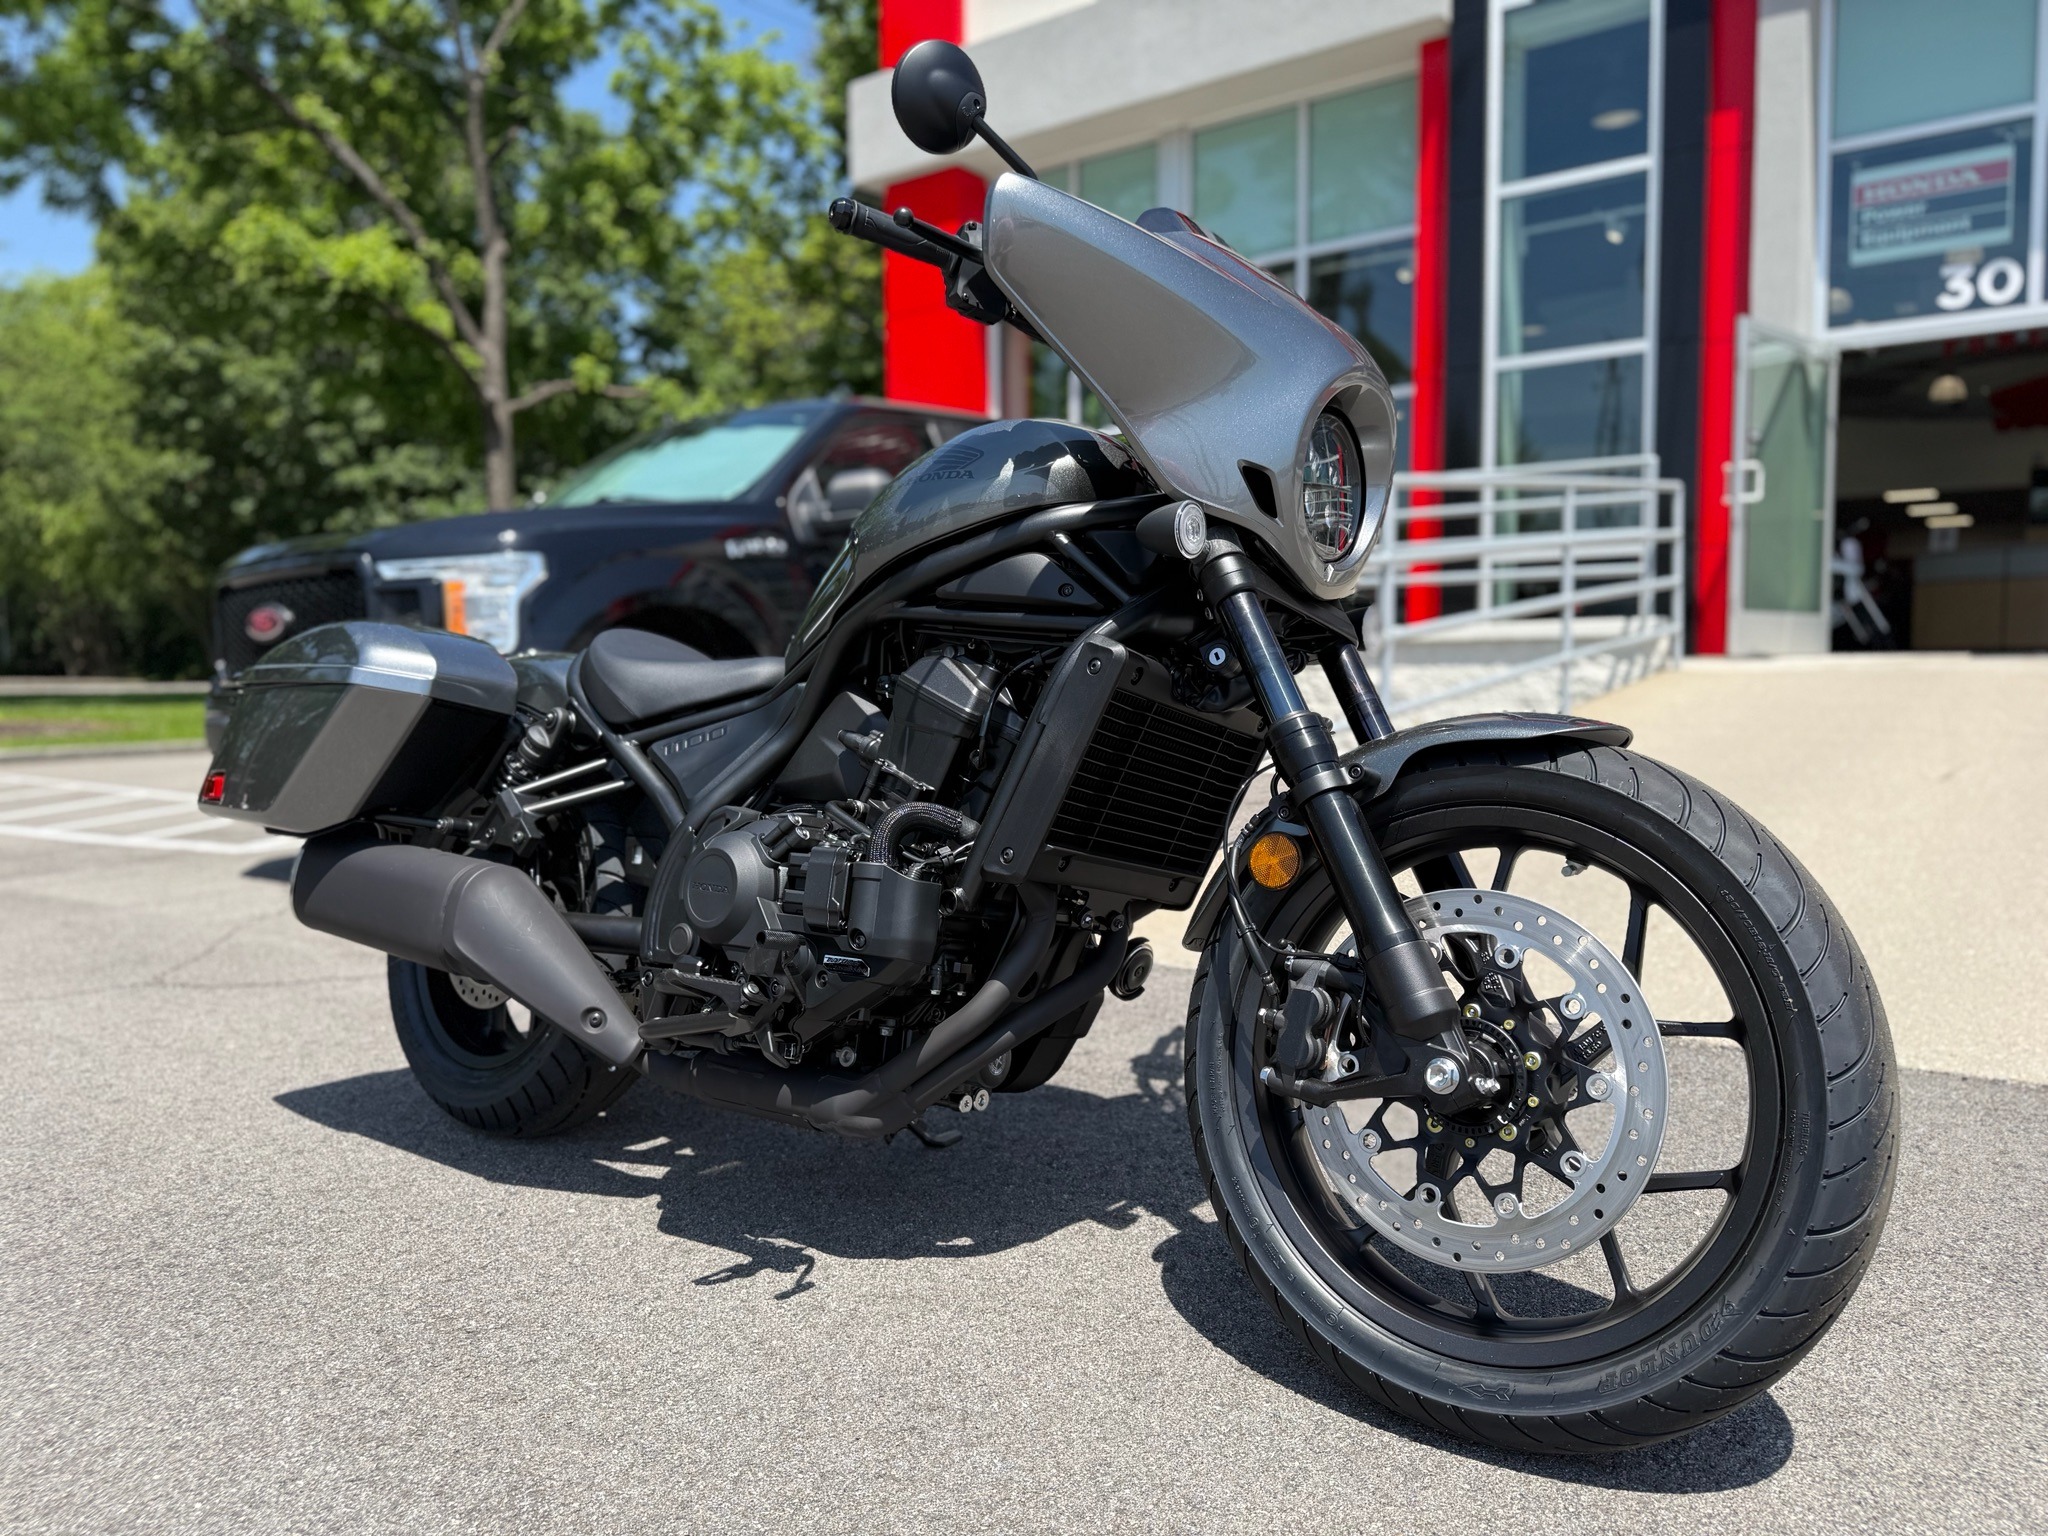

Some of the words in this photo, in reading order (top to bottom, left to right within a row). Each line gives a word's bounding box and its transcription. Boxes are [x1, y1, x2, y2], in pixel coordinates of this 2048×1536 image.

[1864, 167, 1981, 202] HONDA
[1936, 258, 2025, 310] 30
[664, 726, 728, 756] 1100
[1598, 1310, 1722, 1394] DUNLOP
